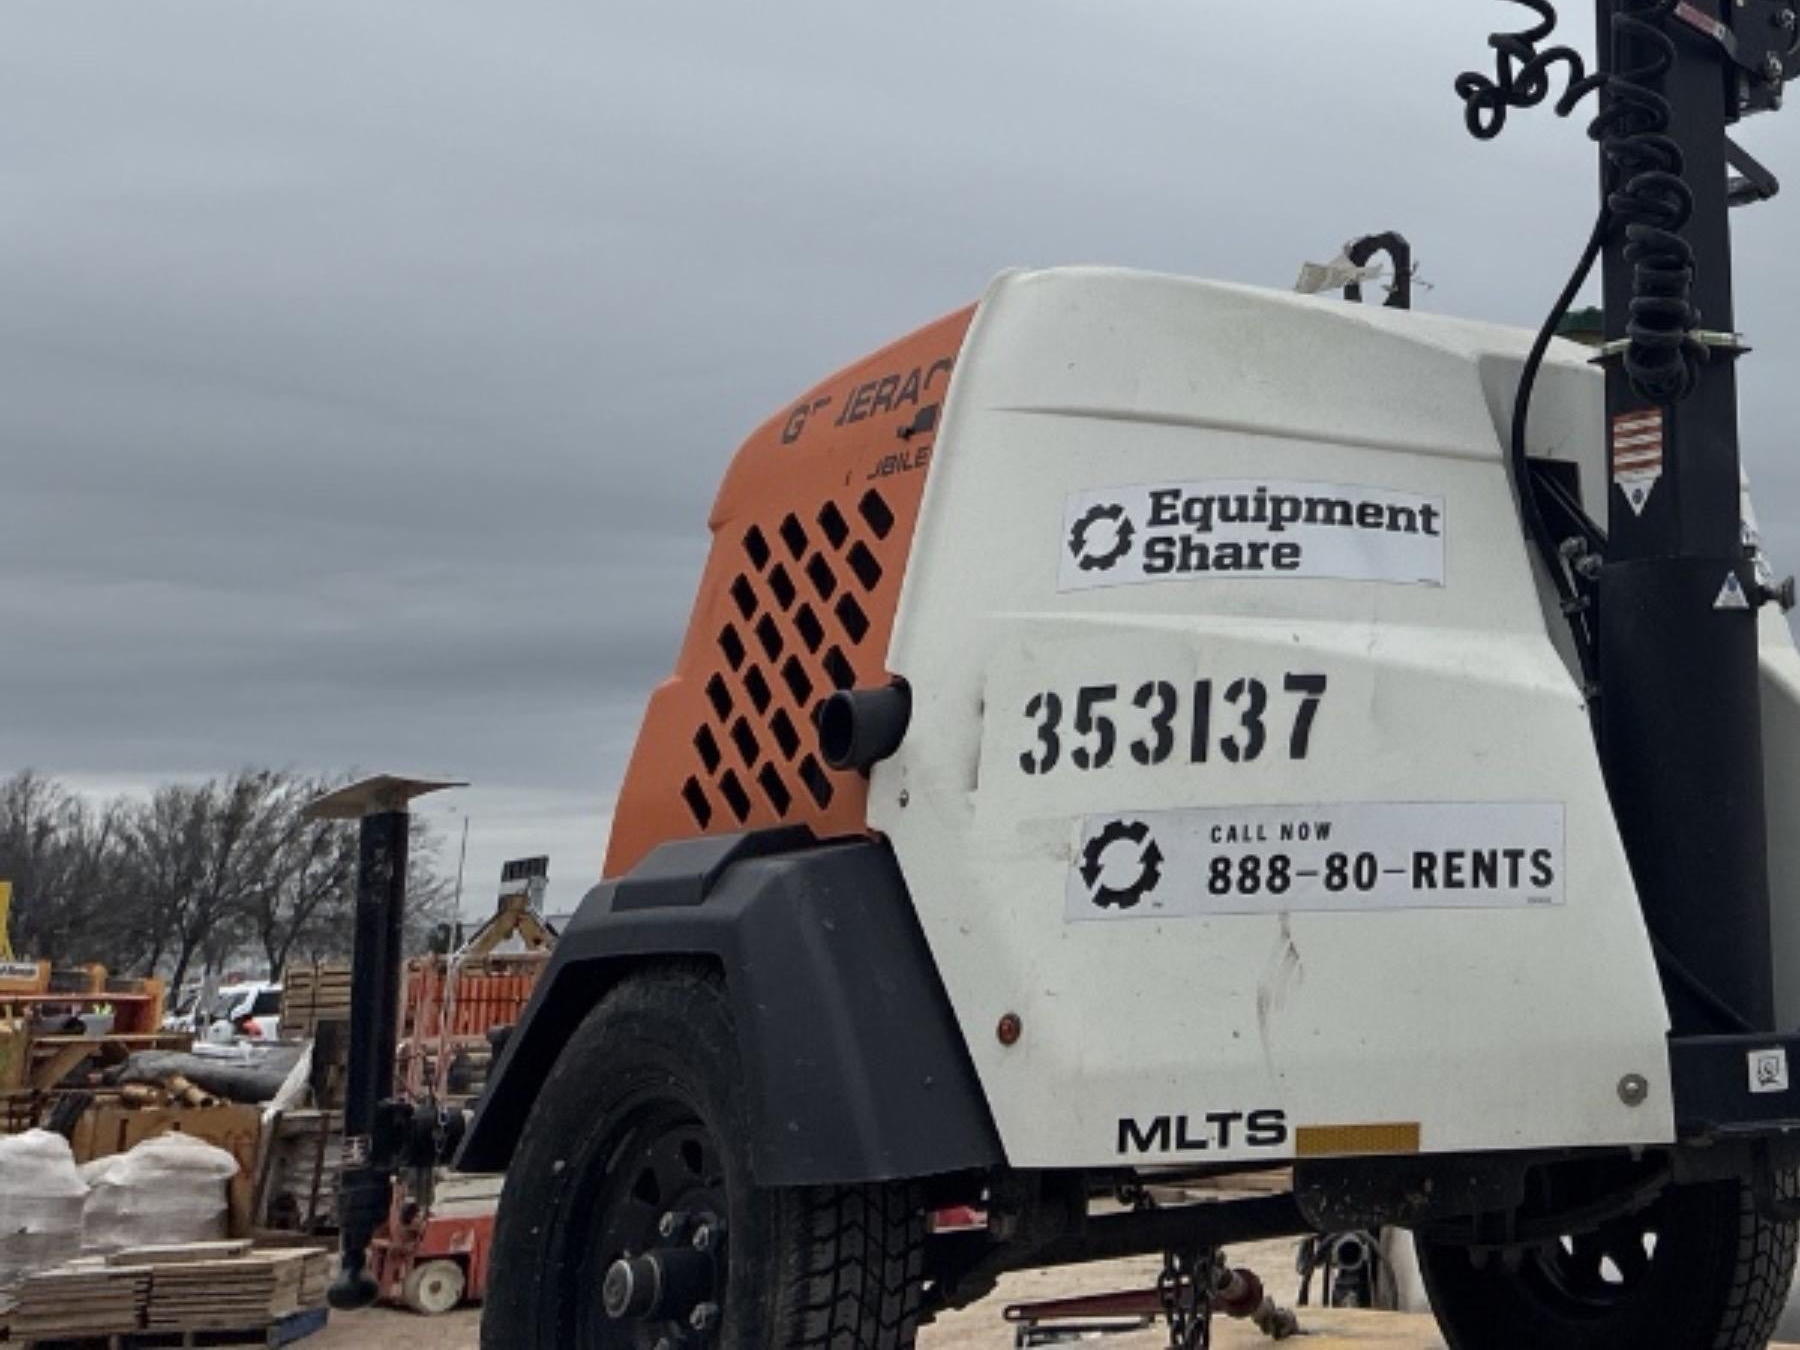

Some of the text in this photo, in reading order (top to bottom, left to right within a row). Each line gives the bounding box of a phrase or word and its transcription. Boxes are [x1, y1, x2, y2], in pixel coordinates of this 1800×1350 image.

[1147, 486, 1440, 537] Equipment
[1142, 535, 1302, 575] Share
[1018, 671, 1328, 776] 353137
[1210, 820, 1332, 844] CALL NOW
[1206, 848, 1555, 896] 888-80-RENTS
[1116, 1107, 1289, 1154] MLTS
